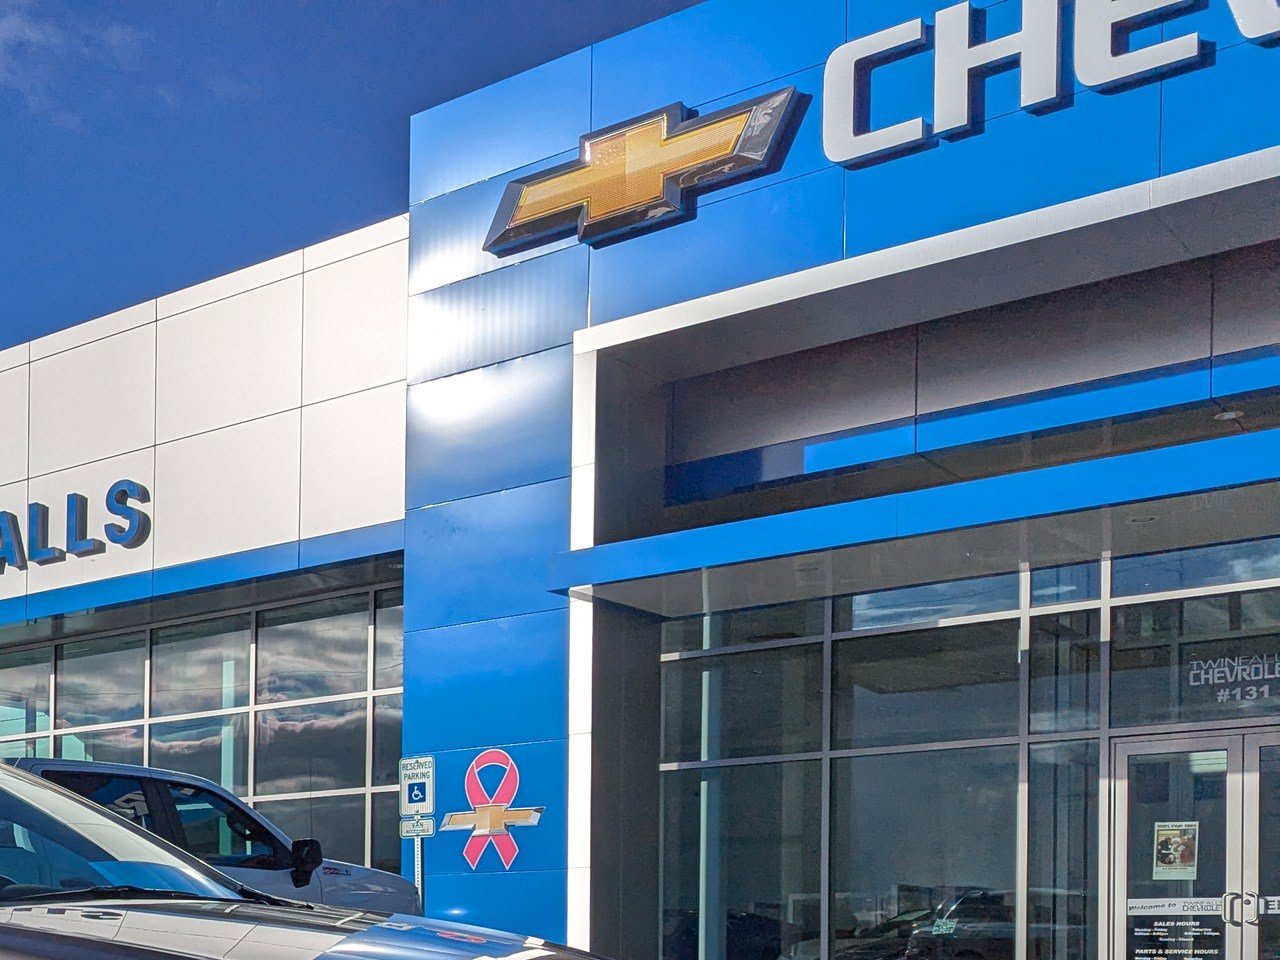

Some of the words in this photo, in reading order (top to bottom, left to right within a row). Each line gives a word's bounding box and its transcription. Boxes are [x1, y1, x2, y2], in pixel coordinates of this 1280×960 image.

[1216, 685, 1270, 703] #131
[402, 761, 433, 771] RESERVED
[404, 771, 431, 781] PARKING
[1129, 902, 1166, 912] Welcome
